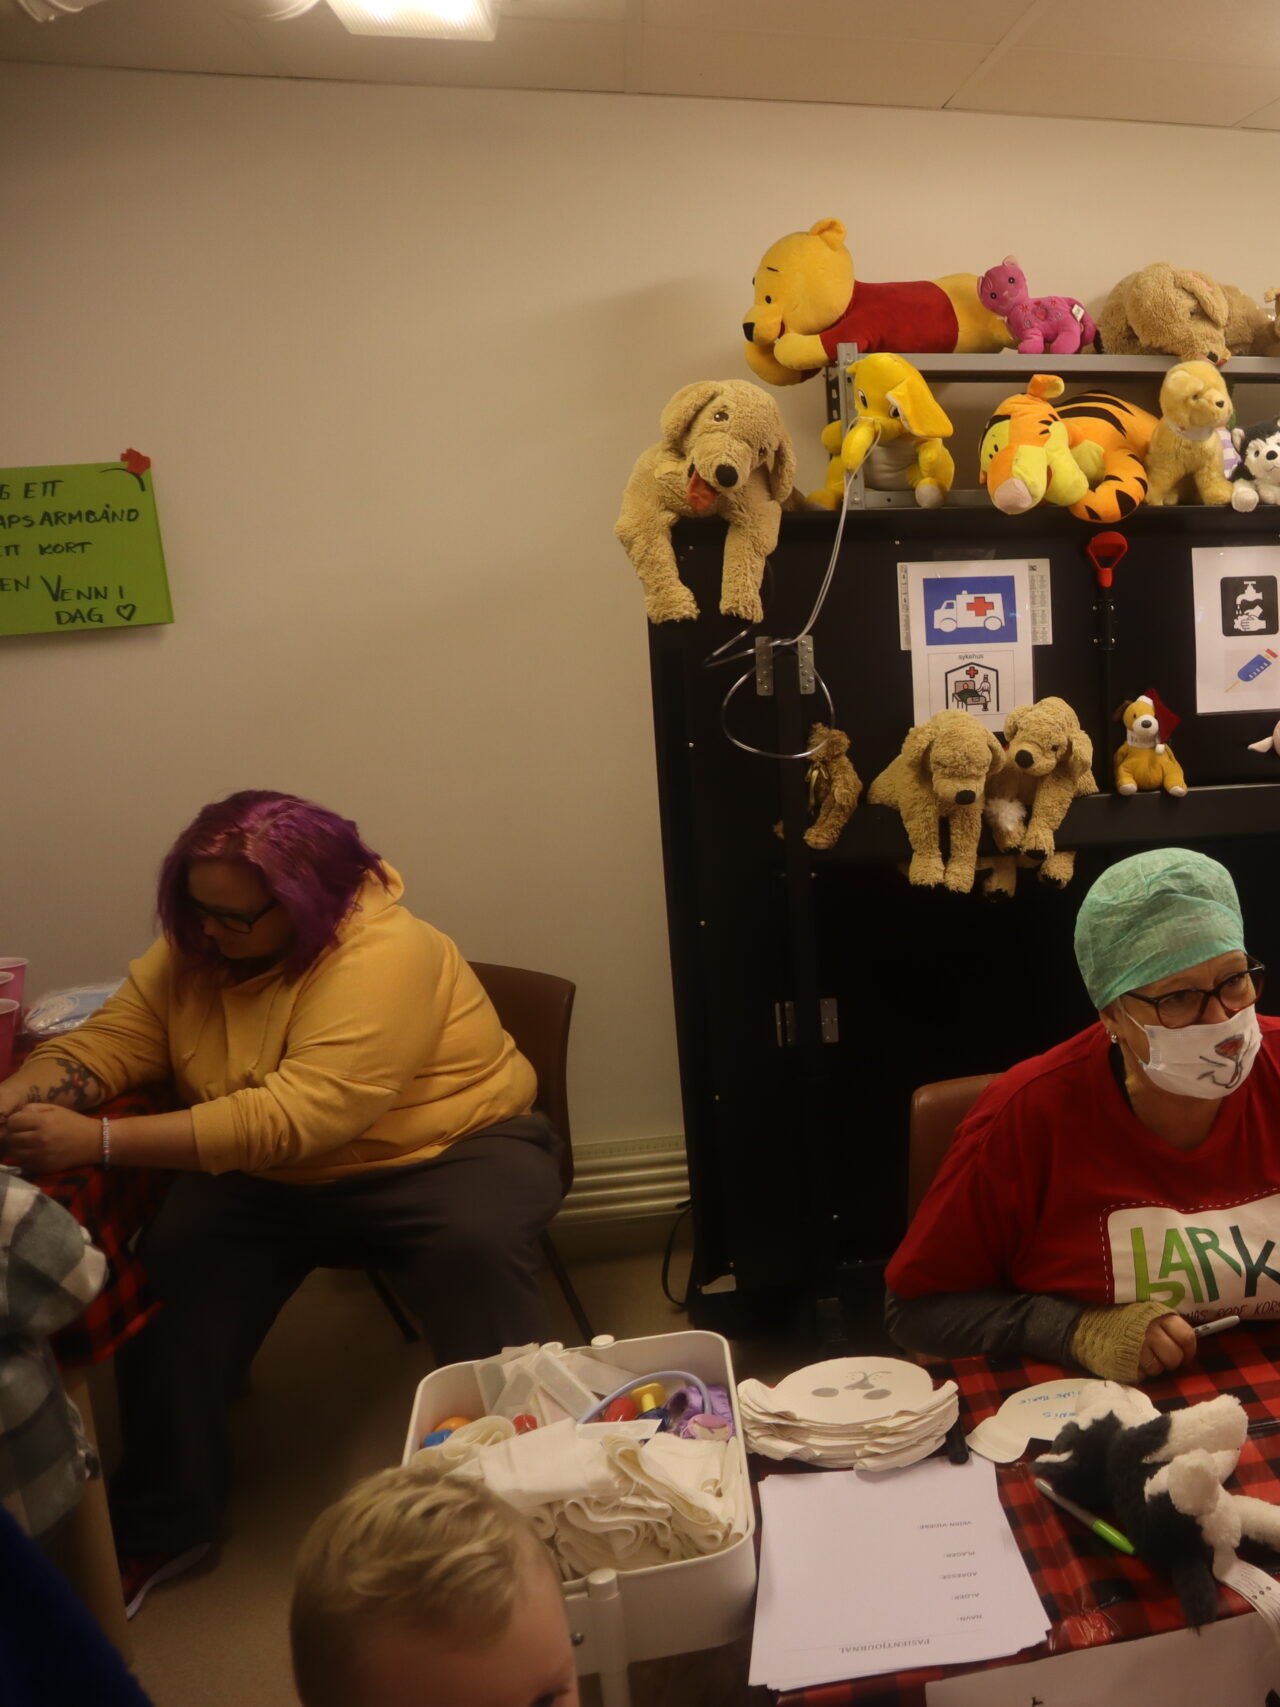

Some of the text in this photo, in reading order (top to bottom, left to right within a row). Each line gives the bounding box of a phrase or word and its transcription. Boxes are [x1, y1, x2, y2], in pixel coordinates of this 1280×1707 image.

[23, 480, 64, 499] ETT
[39, 541, 93, 556] KORT
[0, 575, 30, 592] EN
[40, 575, 108, 602] VENN
[55, 607, 104, 625] DAG
[958, 653, 984, 661] sykehus
[839, 1638, 930, 1654] PASIENTJOURNAL
